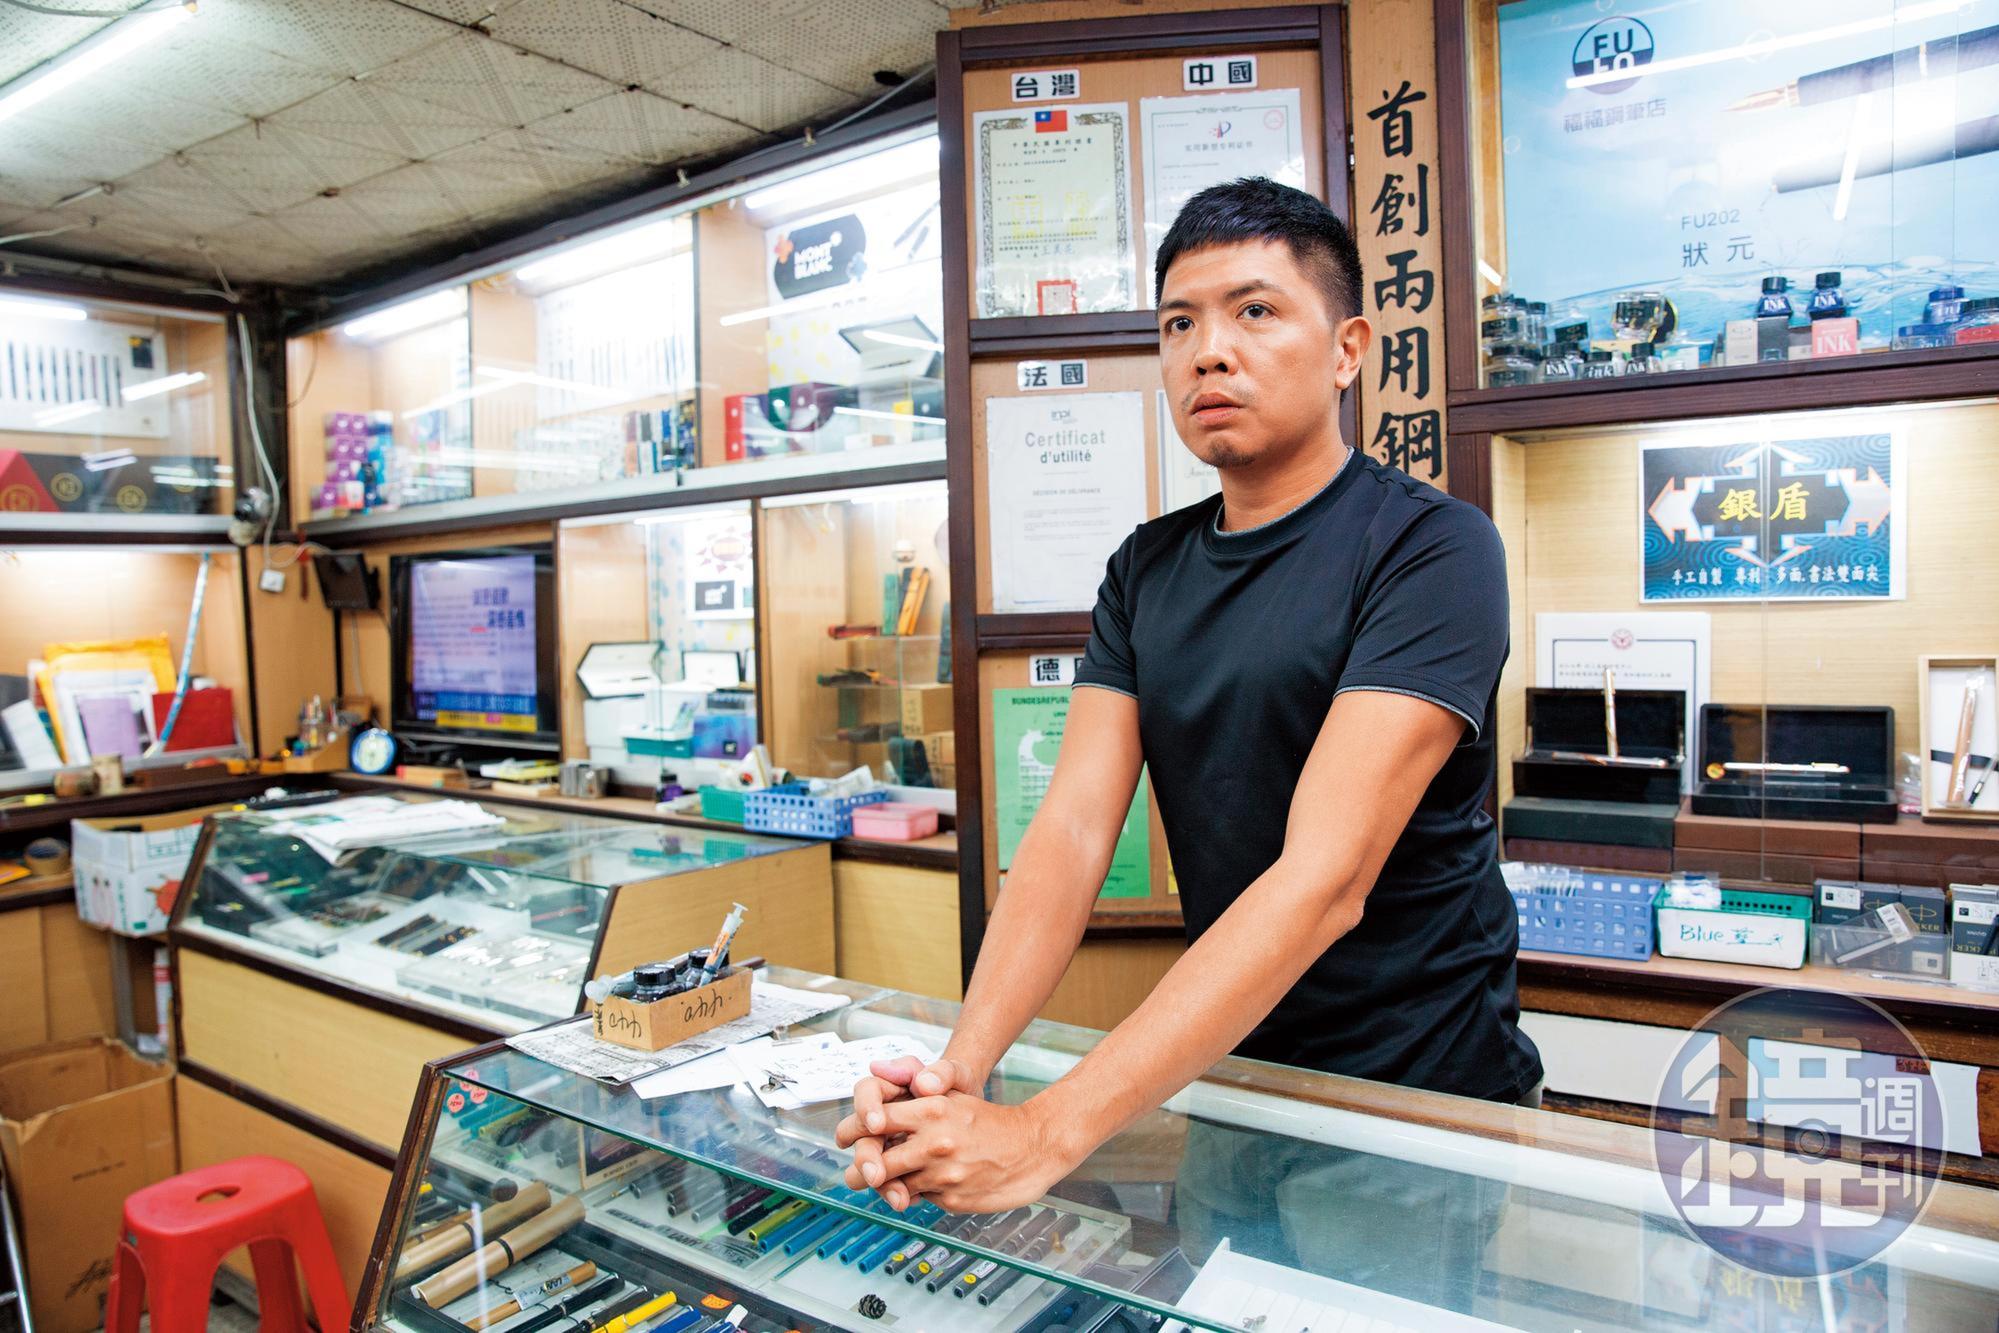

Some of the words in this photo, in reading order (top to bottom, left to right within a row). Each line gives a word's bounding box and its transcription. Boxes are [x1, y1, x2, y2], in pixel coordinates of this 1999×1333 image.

[1189, 60, 1252, 85] 中國
[1016, 74, 1075, 98] 台灣
[1681, 208, 1740, 231] FU202
[1682, 234, 1754, 268] 狀元
[1763, 298, 1787, 311] INK
[1814, 294, 1837, 307] INK
[1817, 332, 1852, 354] INK
[1024, 363, 1084, 387] 法國
[1025, 429, 1106, 447] Certificat
[1040, 448, 1092, 464] d'utilité
[1718, 481, 1811, 522] 銀盾
[1680, 924, 1724, 942] Blue
